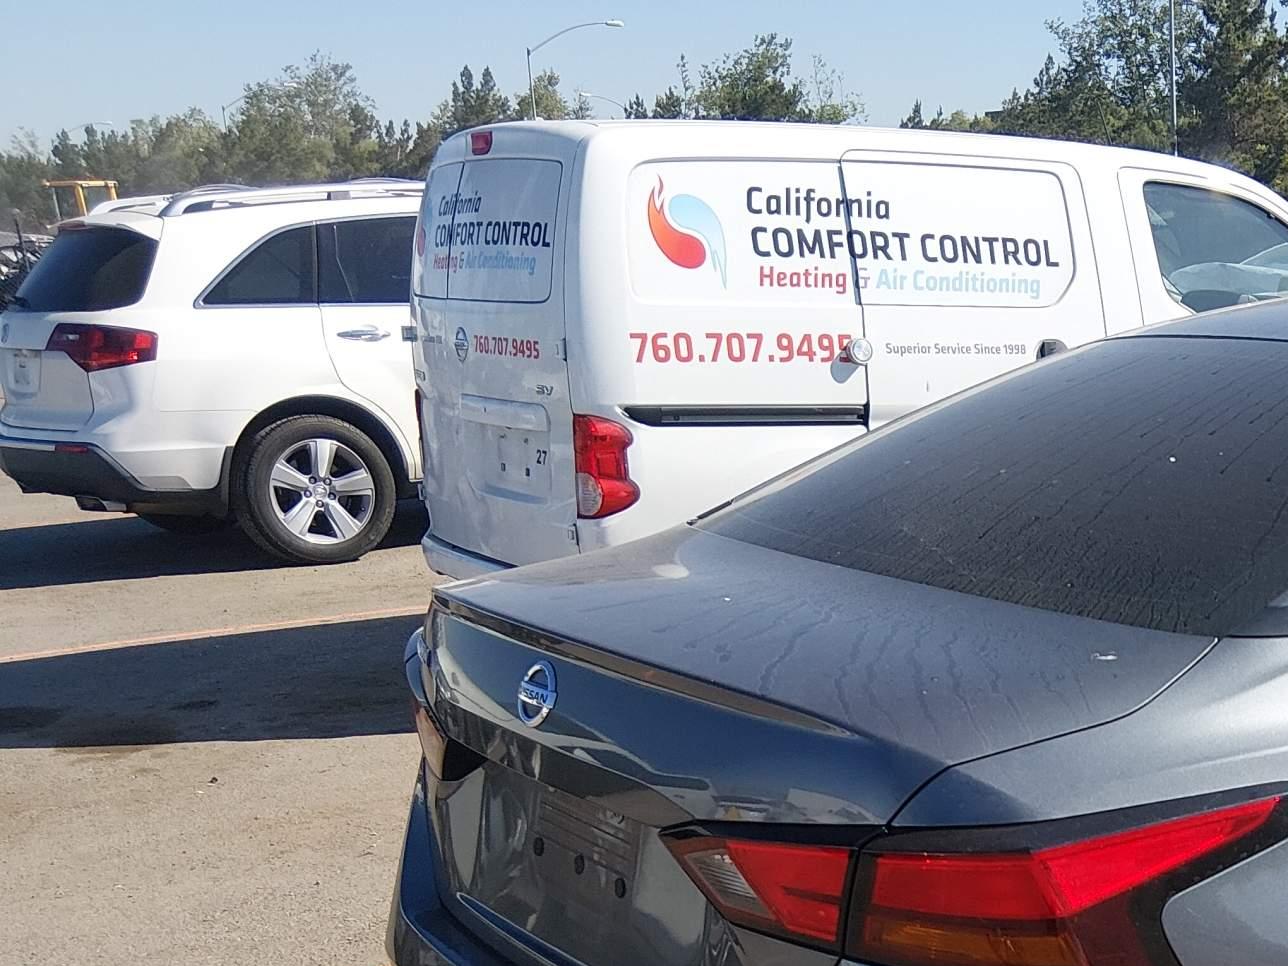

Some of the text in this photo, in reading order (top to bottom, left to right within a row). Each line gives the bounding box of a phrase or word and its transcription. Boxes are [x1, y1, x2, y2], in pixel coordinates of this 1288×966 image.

[438, 190, 482, 216] California
[746, 186, 890, 225] California
[434, 220, 551, 248] COMFORT CONTROL
[751, 226, 1060, 267] COMFORT CONTROL
[433, 253, 458, 274] Heatng
[458, 251, 465, 270] &
[759, 265, 847, 295] Heating
[876, 268, 907, 291] Air
[913, 269, 1041, 300] Conditioning
[473, 334, 540, 360] 760.707.9495
[629, 332, 857, 363] 760.707.9495
[885, 342, 1026, 357] Superior Service Since 1998
[535, 448, 548, 465] 27
[519, 687, 549, 703] SSAN
